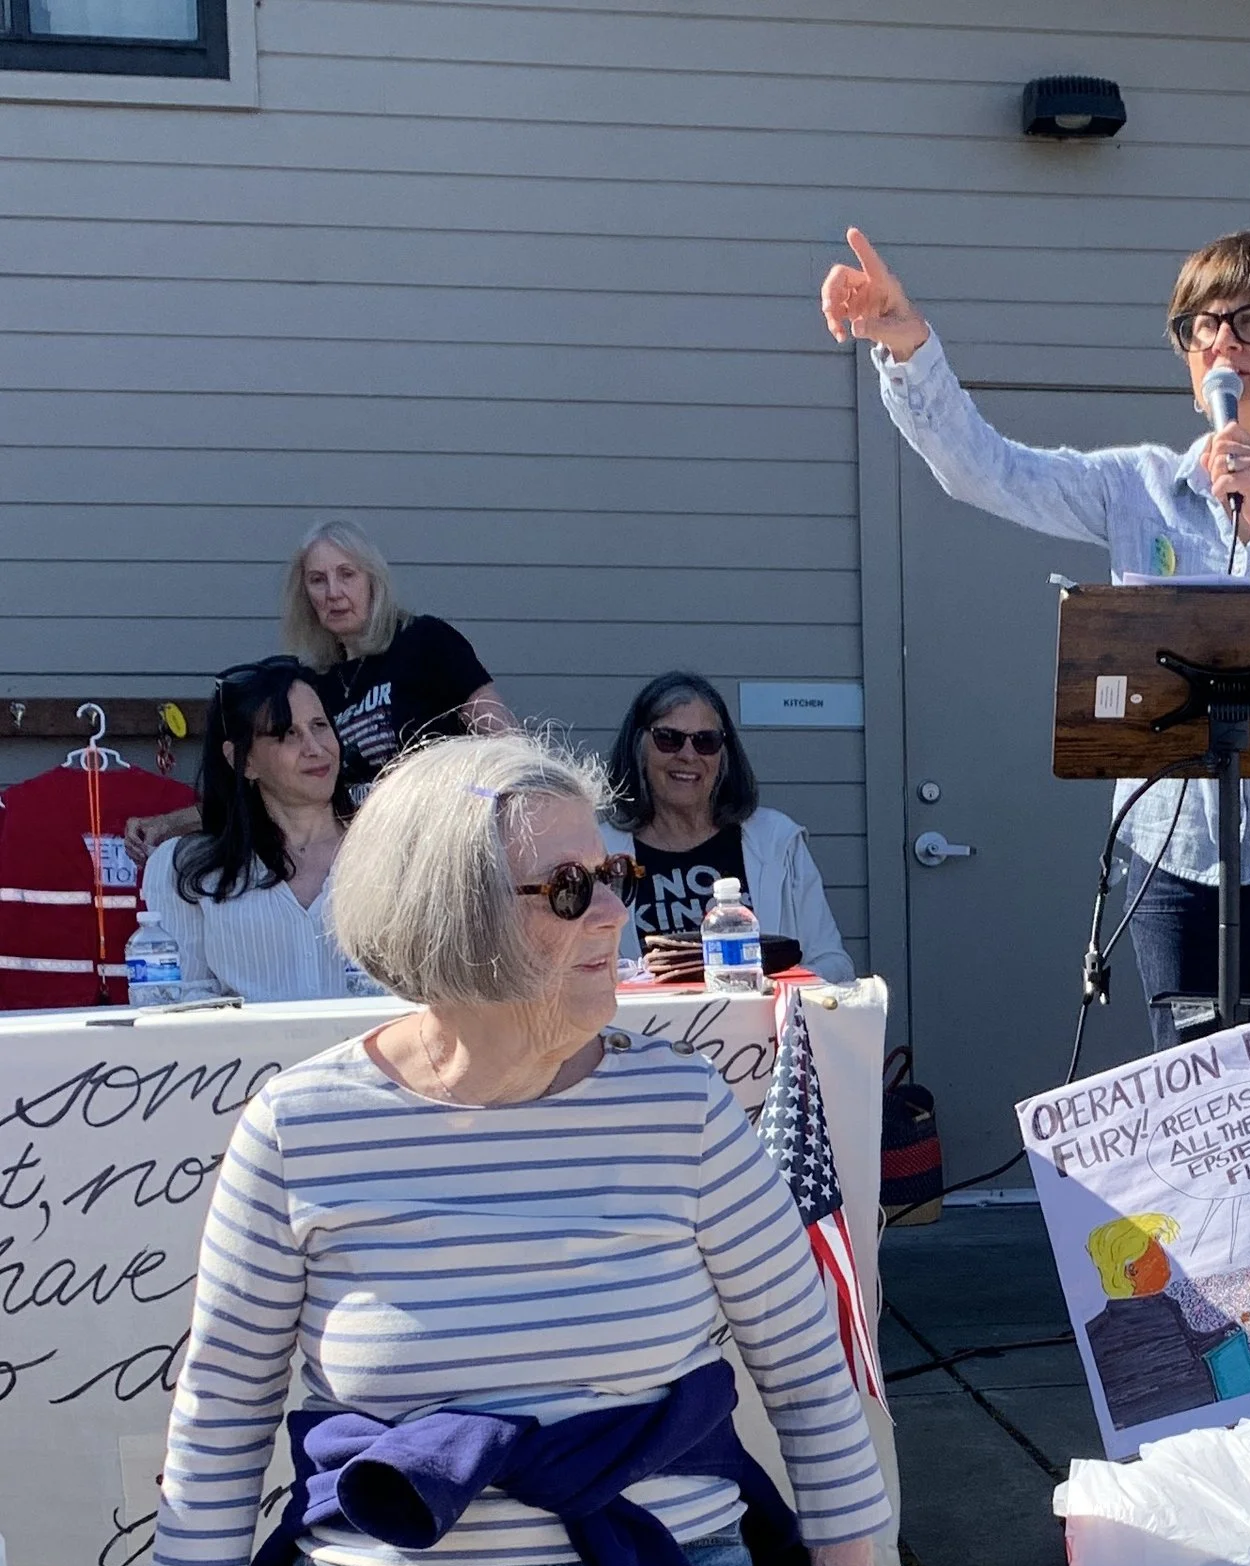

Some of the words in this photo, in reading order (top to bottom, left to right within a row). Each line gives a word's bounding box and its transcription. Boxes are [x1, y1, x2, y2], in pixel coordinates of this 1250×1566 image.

[783, 699, 824, 708] KITCHEN
[652, 865, 722, 901] NO
[1031, 1043, 1221, 1141] OPERATION
[1051, 1109, 1149, 1178] FURY!
[1170, 1128, 1216, 1162] ALL
